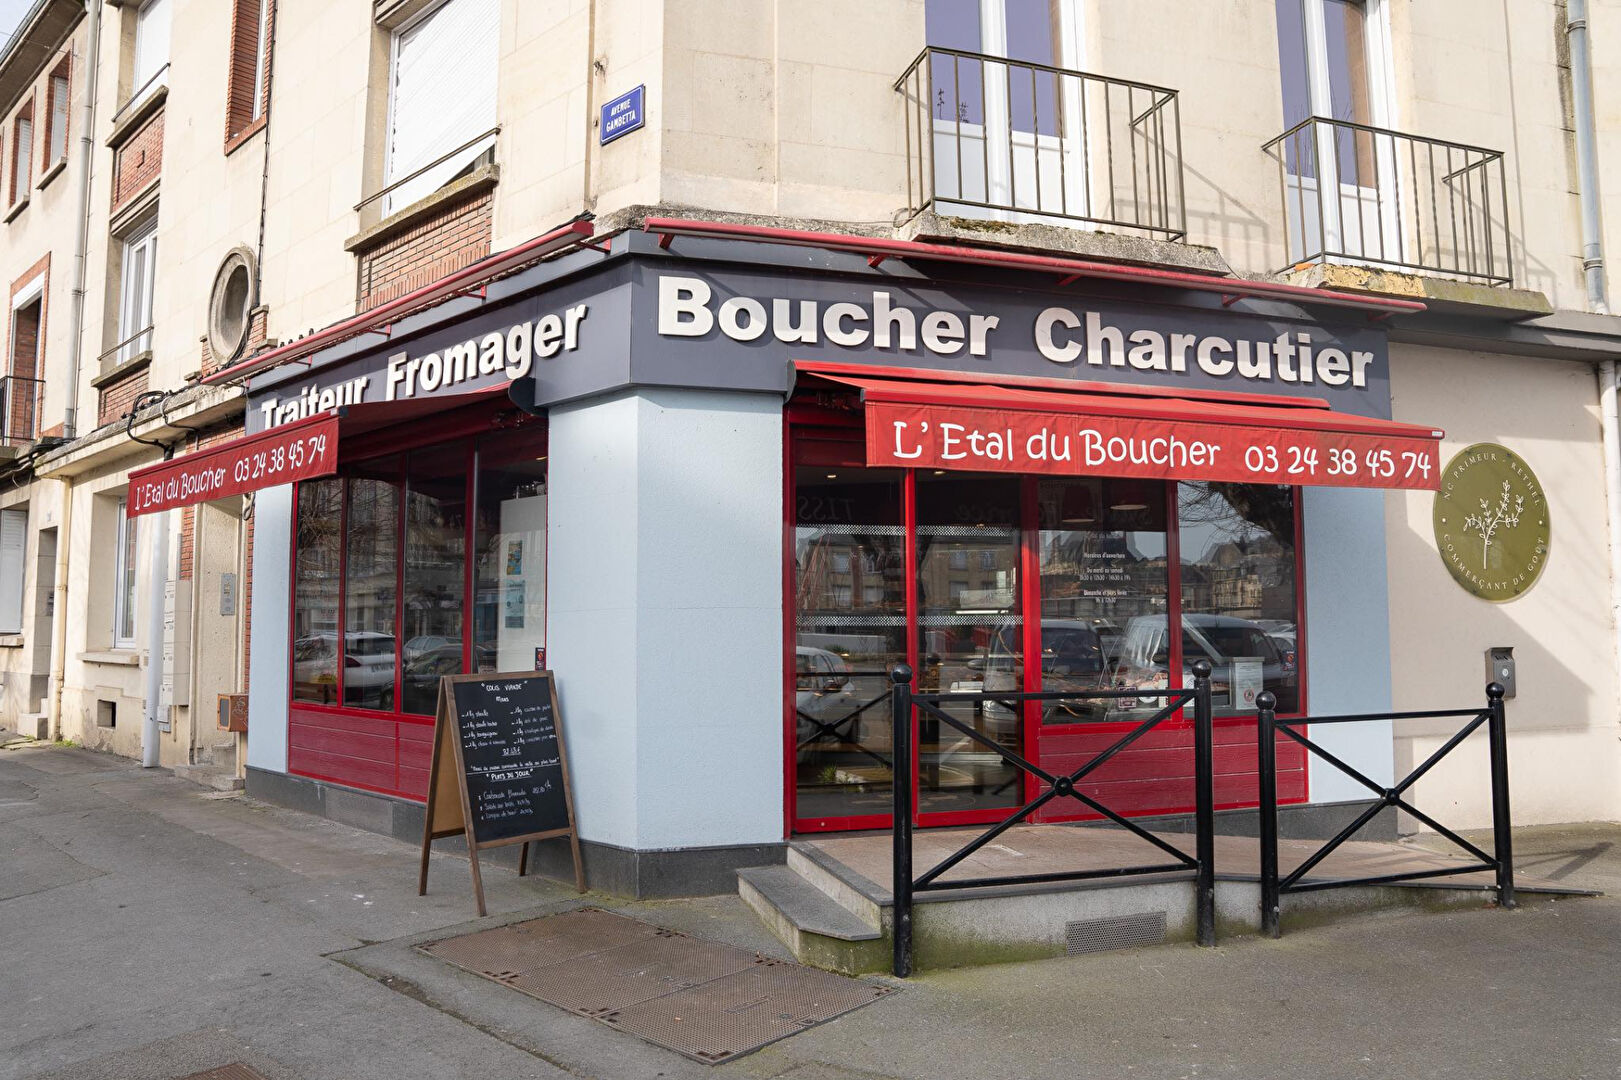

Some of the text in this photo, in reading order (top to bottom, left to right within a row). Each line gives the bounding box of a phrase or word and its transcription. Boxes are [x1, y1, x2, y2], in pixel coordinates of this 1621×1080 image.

[606, 109, 636, 133] GAMBETTA
[611, 99, 631, 117] AVENUE
[658, 275, 1375, 388] Boucher Charcutier
[261, 303, 590, 430] Traiteur Fromager
[166, 477, 178, 500] du
[180, 467, 226, 500] Boucher
[234, 457, 250, 483] 03
[252, 452, 267, 479] 24
[268, 446, 285, 474] 38
[288, 439, 304, 470] 45
[308, 433, 327, 465] 74
[1026, 427, 1071, 461] du
[1079, 428, 1221, 468] Boucher
[1244, 445, 1279, 474] 03
[1287, 446, 1319, 476] 24
[1327, 448, 1357, 476] 38
[1365, 449, 1395, 478] 45
[1401, 450, 1432, 480] 74
[1454, 452, 1497, 479] PRIMEUR
[1511, 461, 1540, 507] RETHEL
[1513, 574, 1525, 586] DE
